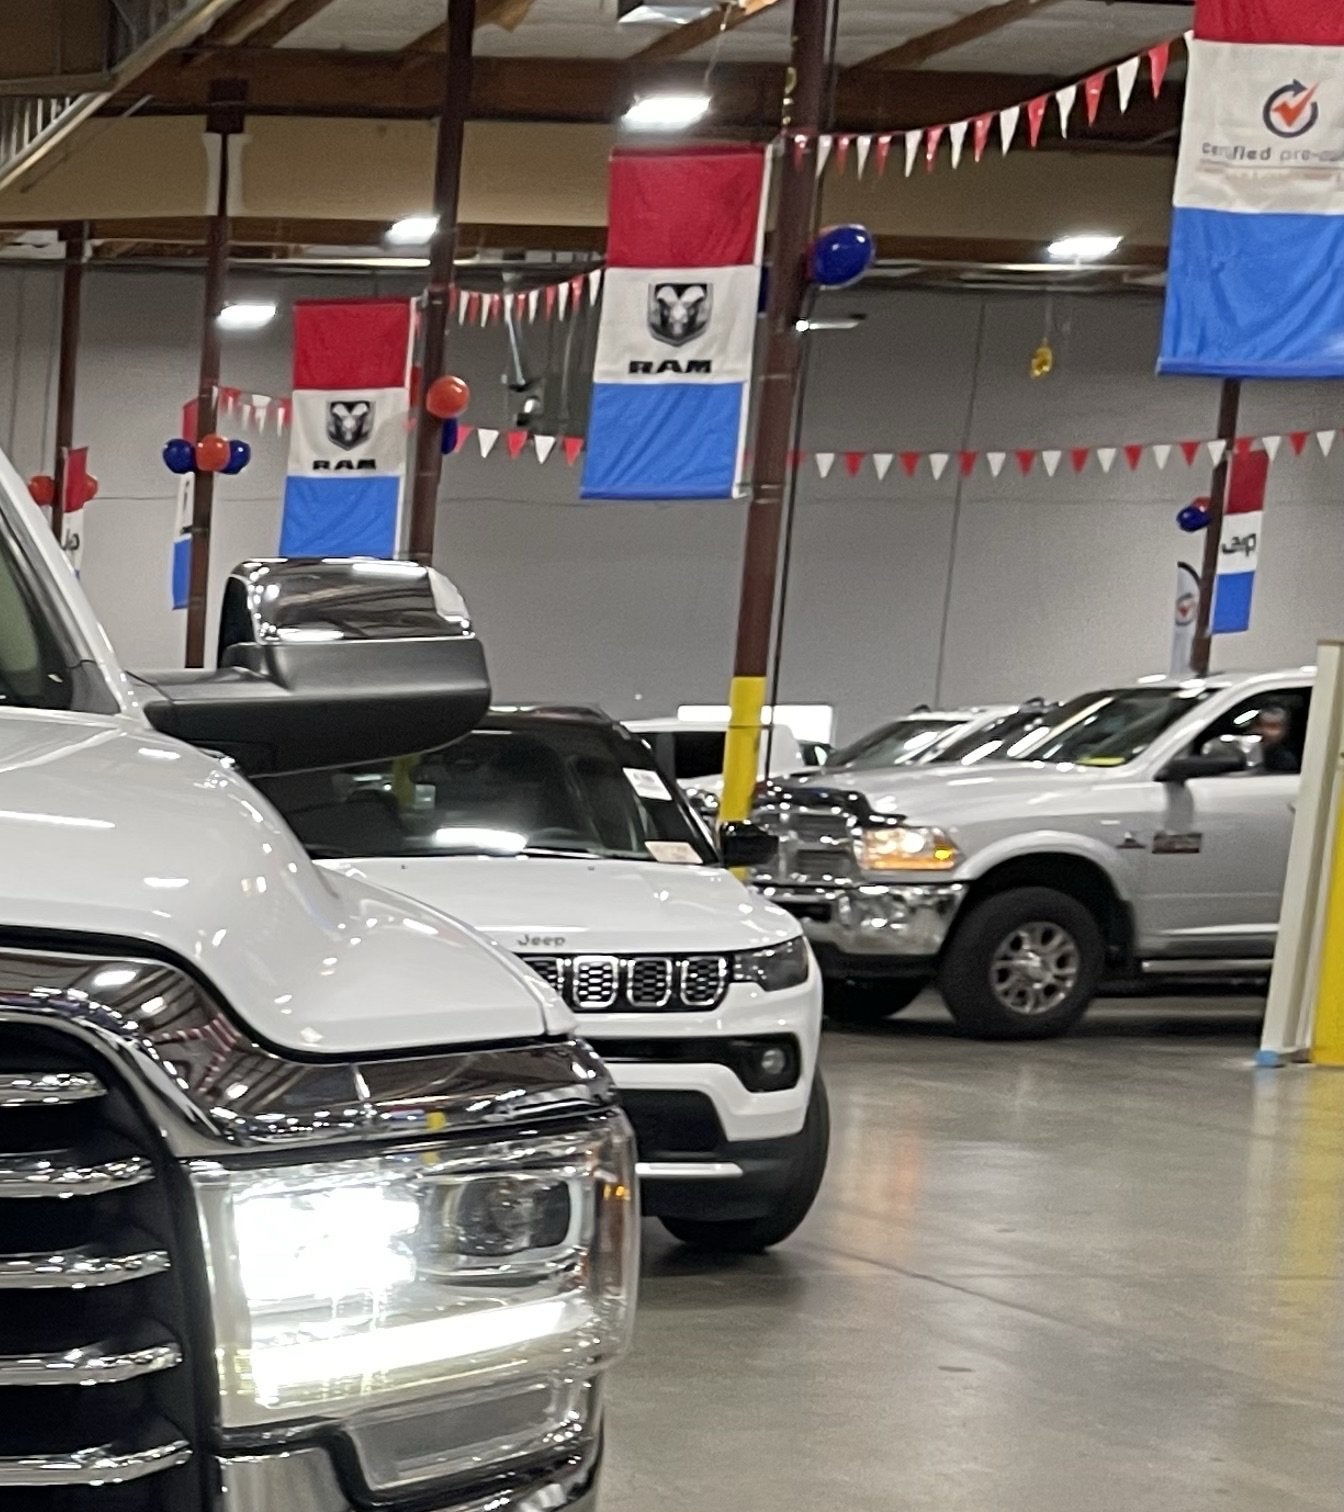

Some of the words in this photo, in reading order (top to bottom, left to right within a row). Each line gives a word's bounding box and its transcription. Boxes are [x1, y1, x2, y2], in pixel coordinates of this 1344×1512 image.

[628, 359, 712, 374] RAM
[313, 459, 376, 470] RAM
[517, 934, 566, 947] Jeep
